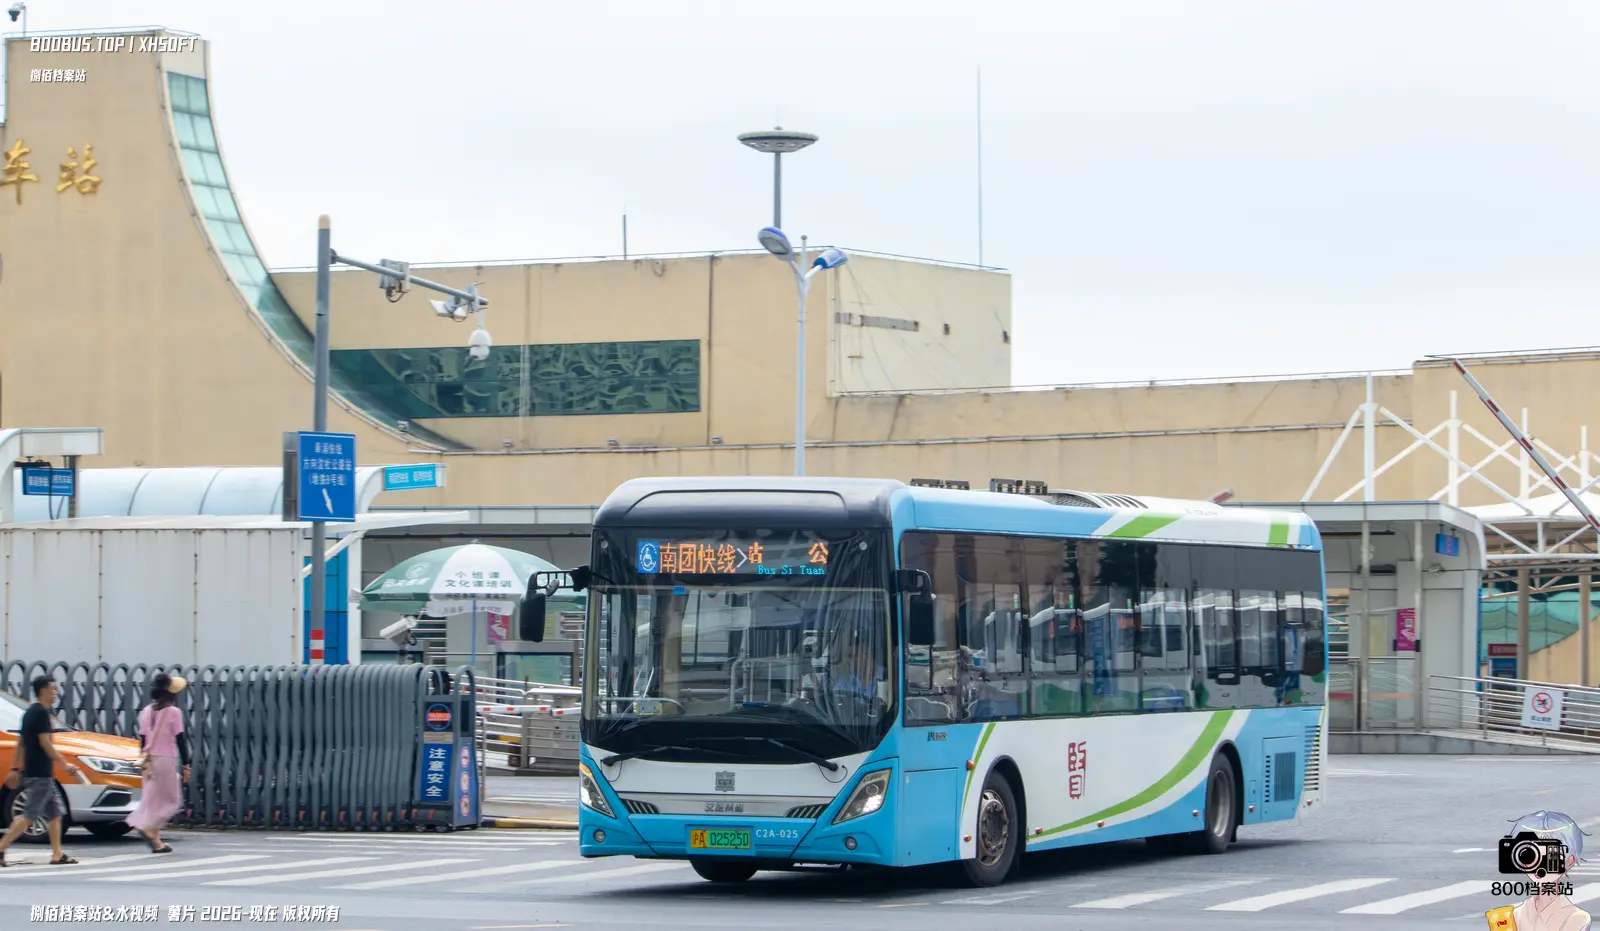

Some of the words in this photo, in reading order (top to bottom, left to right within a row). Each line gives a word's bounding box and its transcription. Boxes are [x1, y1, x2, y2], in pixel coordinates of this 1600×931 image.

[659, 542, 736, 574] 南团快线
[808, 542, 829, 564] 公
[757, 564, 777, 575] Bus
[781, 565, 793, 575] Si
[800, 565, 825, 575] Tuan
[425, 747, 447, 797] 注意安全
[755, 829, 798, 838] C2A-025
